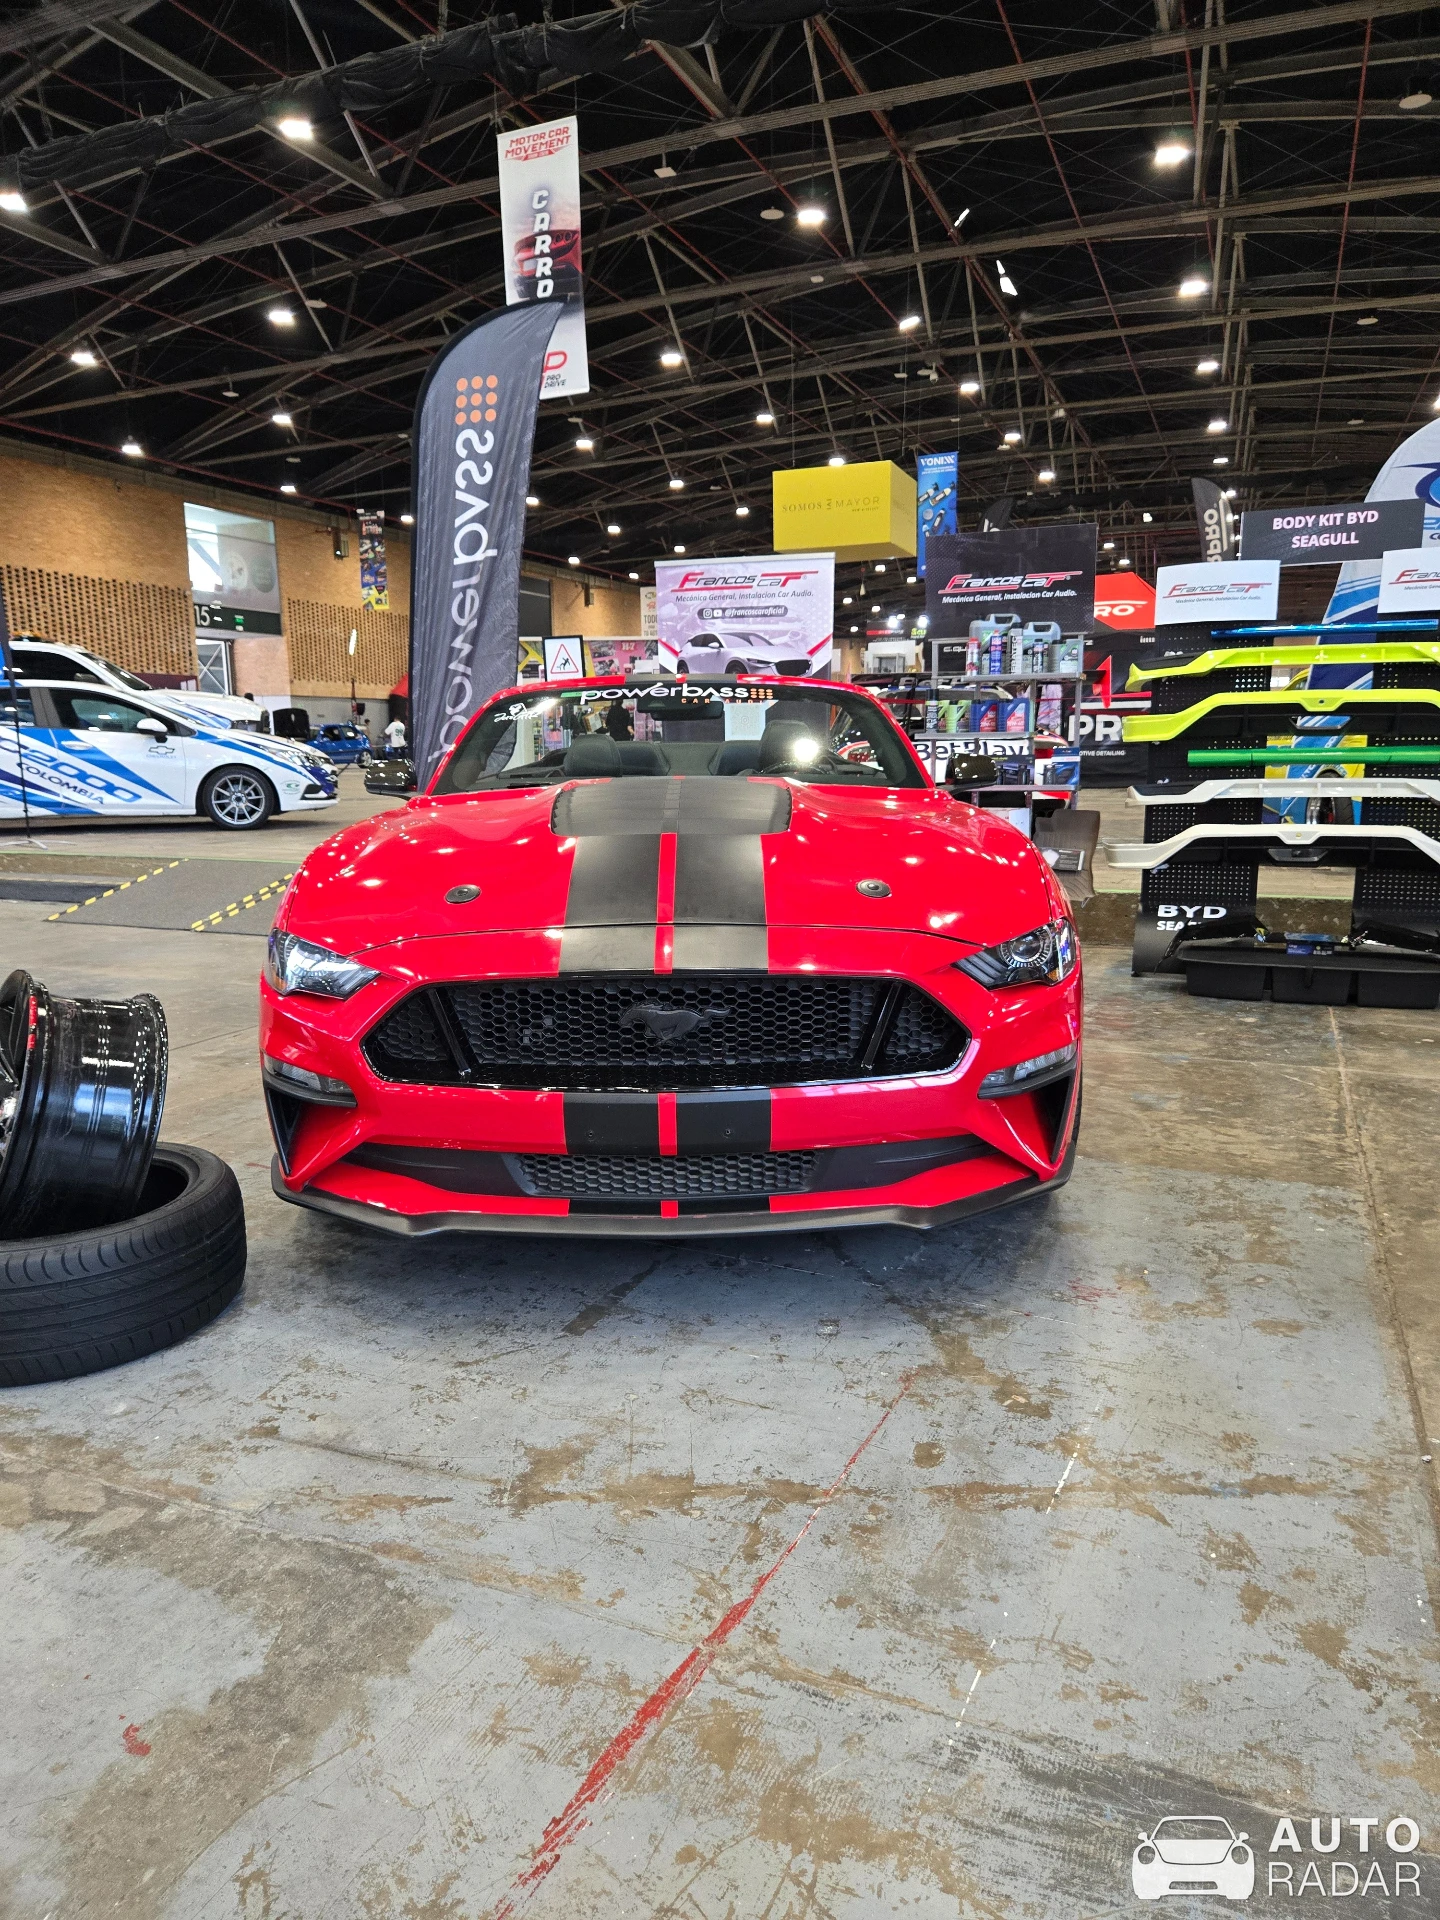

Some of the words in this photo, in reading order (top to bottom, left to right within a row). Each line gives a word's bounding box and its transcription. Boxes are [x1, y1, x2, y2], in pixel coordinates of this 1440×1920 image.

[509, 132, 547, 147] MOTOR
[548, 126, 569, 138] CAR
[505, 135, 572, 158] MOVEMENT
[782, 501, 822, 512] SOMOS
[835, 496, 880, 508] MAYOR
[1272, 514, 1316, 530] BODY
[1318, 512, 1344, 527] KIT
[1346, 510, 1379, 525] BYD
[1291, 531, 1359, 548] SEAGULL
[675, 594, 707, 603] Mecánica
[708, 592, 737, 602] General,
[738, 590, 776, 600] Instalacion
[777, 590, 790, 599] Car
[791, 588, 814, 598] Audio.
[974, 593, 1003, 602] General,
[1041, 591, 1054, 599] Car
[724, 606, 786, 618] @francoscaroficial
[1096, 749, 1126, 757] DETAILING
[16, 762, 104, 805] COLOMBIA
[1157, 904, 1227, 918] BYD
